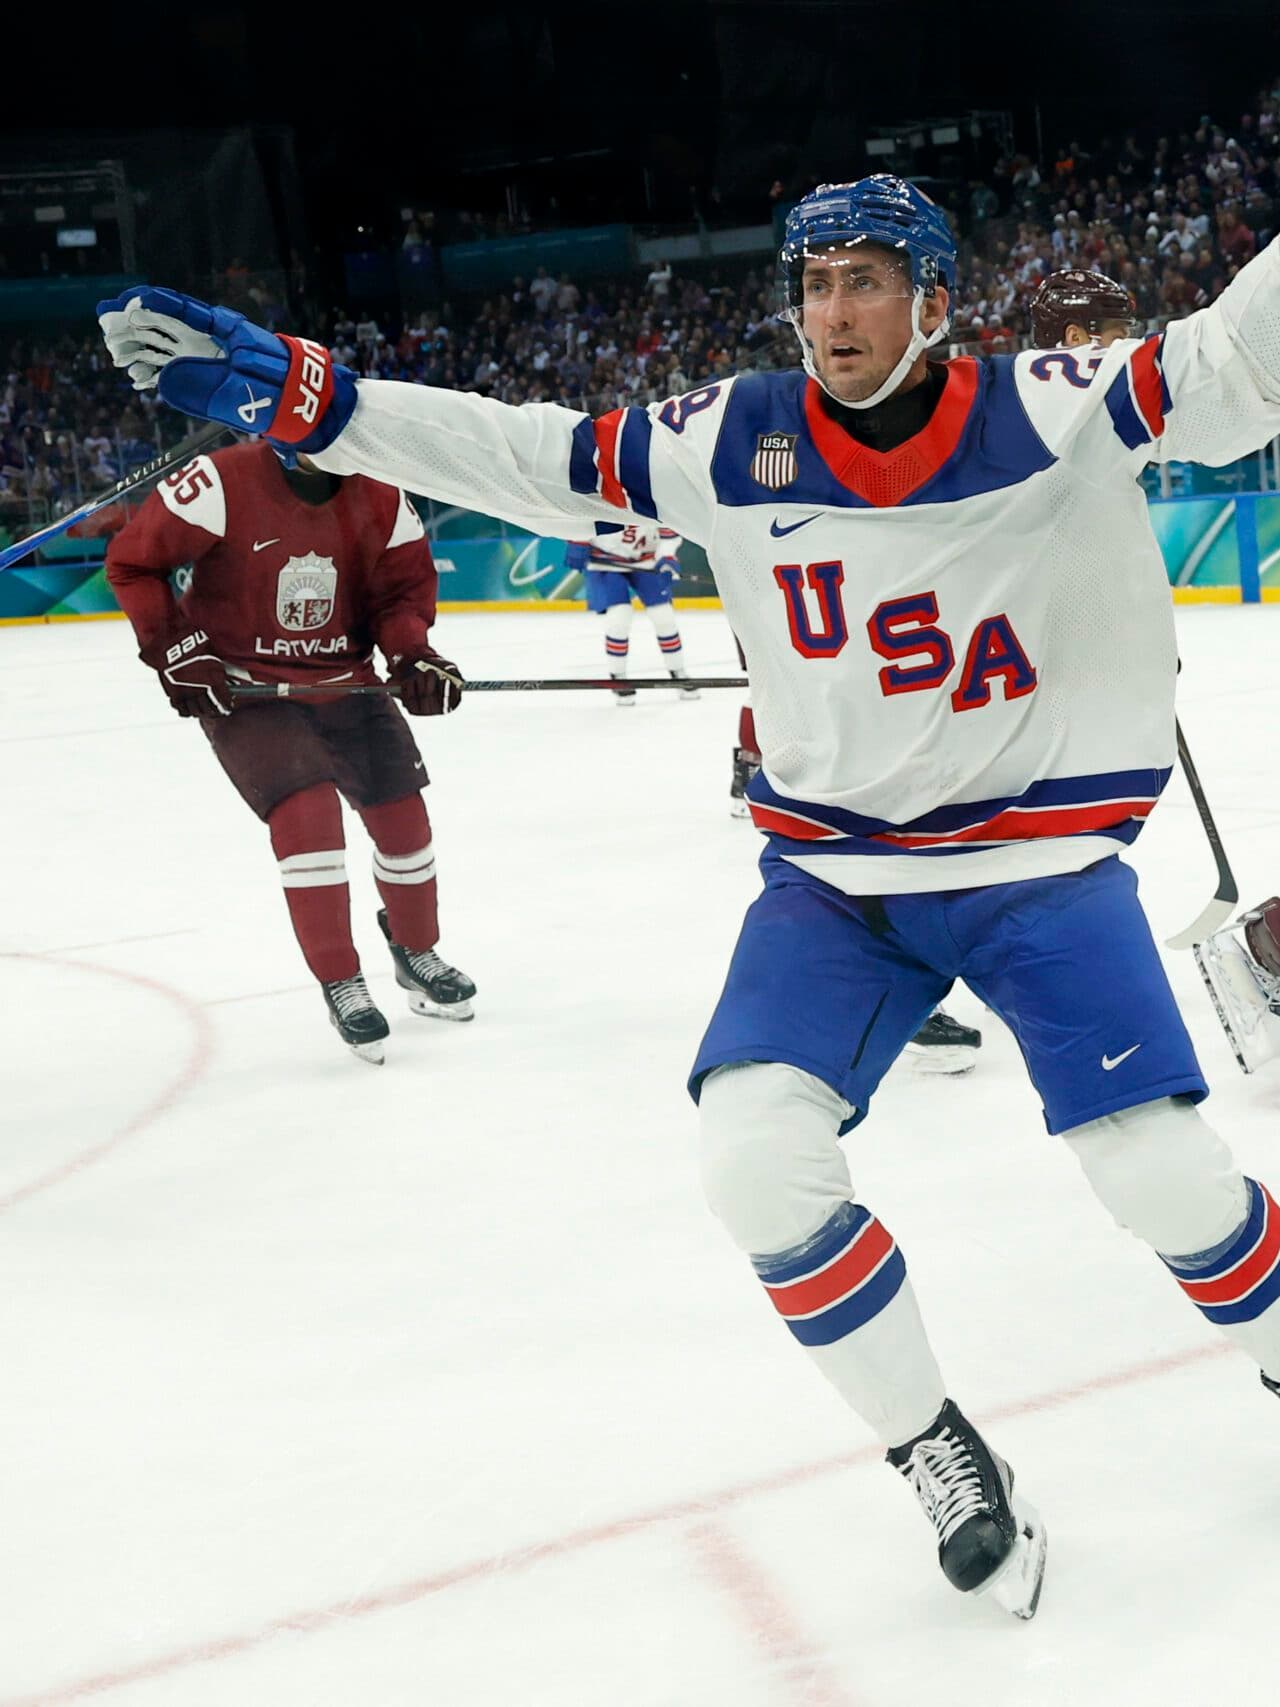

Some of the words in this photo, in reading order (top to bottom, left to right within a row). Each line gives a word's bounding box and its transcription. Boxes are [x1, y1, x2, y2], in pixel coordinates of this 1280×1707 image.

[762, 437, 789, 449] USA
[255, 635, 348, 657] LATVIJA
[773, 560, 1037, 713] USA
